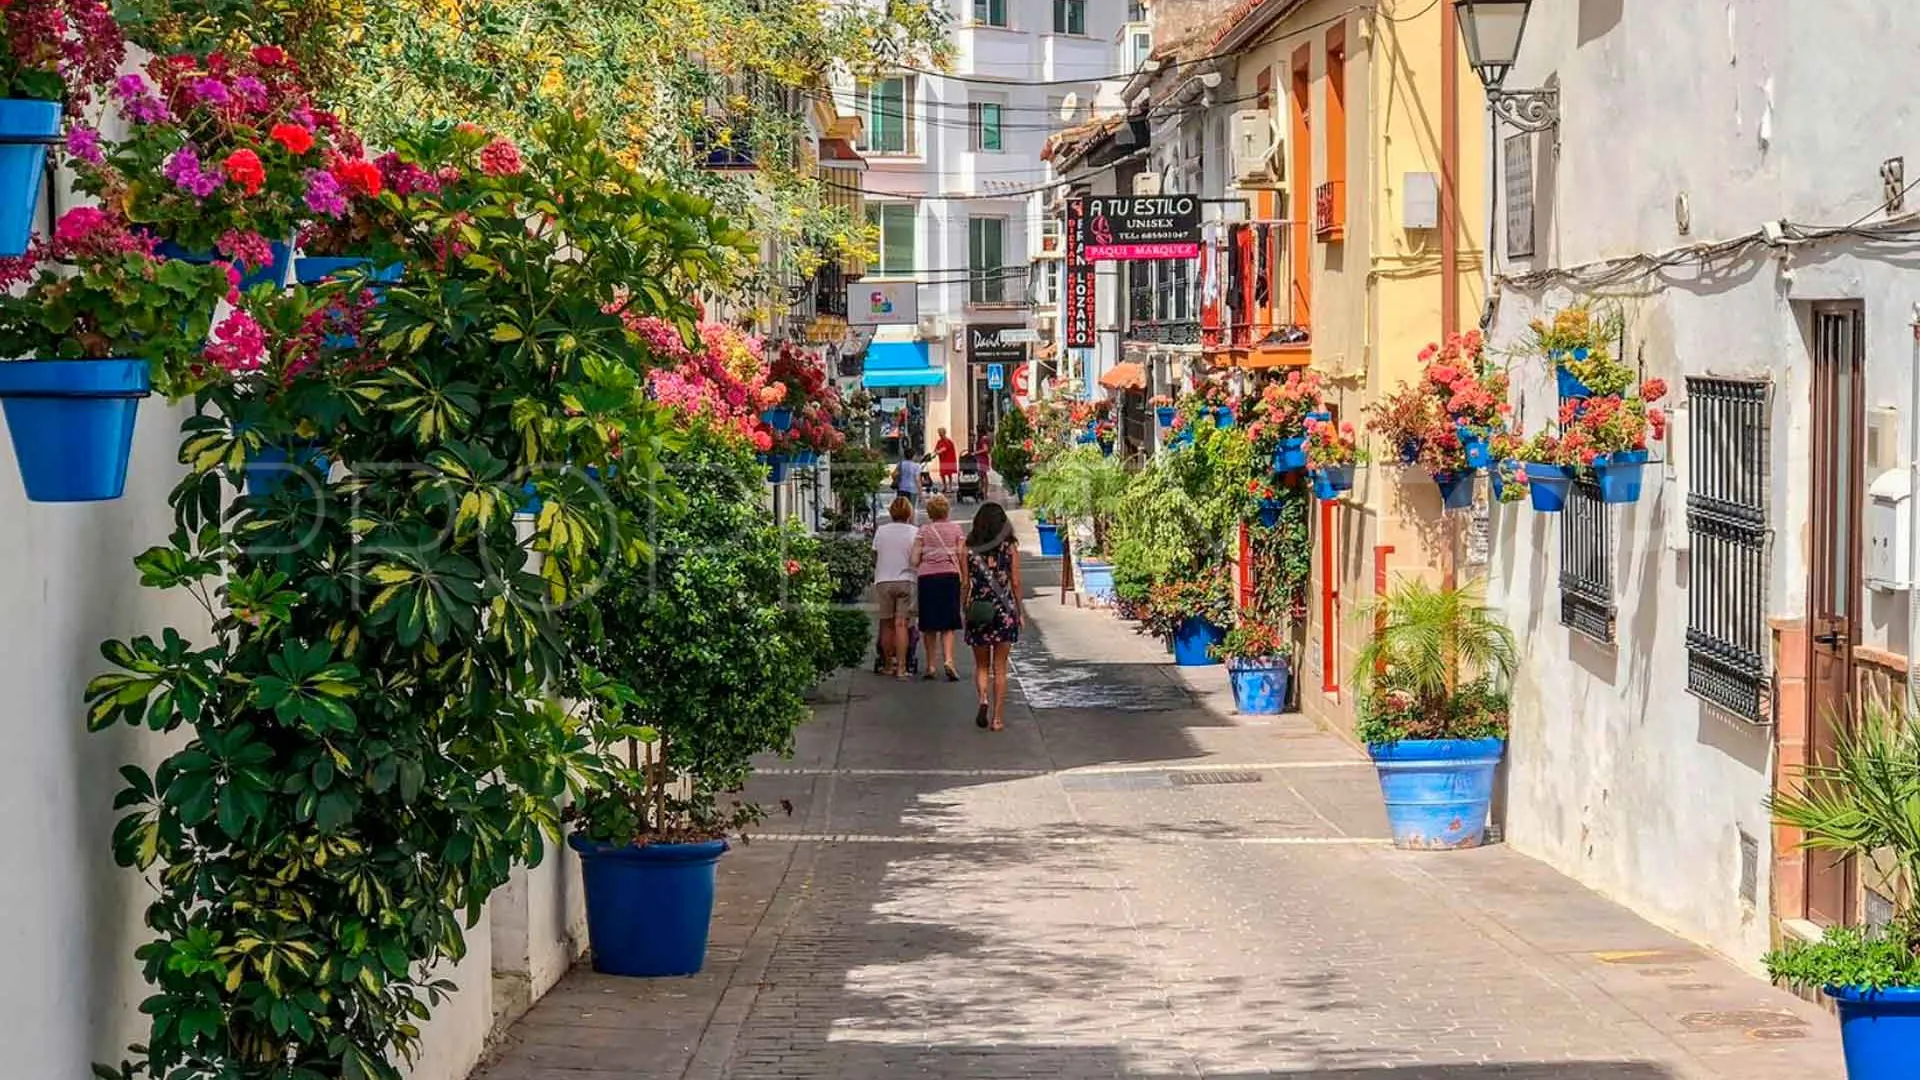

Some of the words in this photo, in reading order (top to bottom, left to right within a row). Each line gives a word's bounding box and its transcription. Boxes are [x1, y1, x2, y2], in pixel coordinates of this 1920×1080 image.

[1090, 200, 1102, 216] A
[1108, 199, 1129, 216] TU
[1134, 198, 1193, 215] ESTILO
[1126, 218, 1174, 228] UNISEX
[1091, 246, 1127, 256] PAQUI
[1076, 272, 1086, 343] LOZANO
